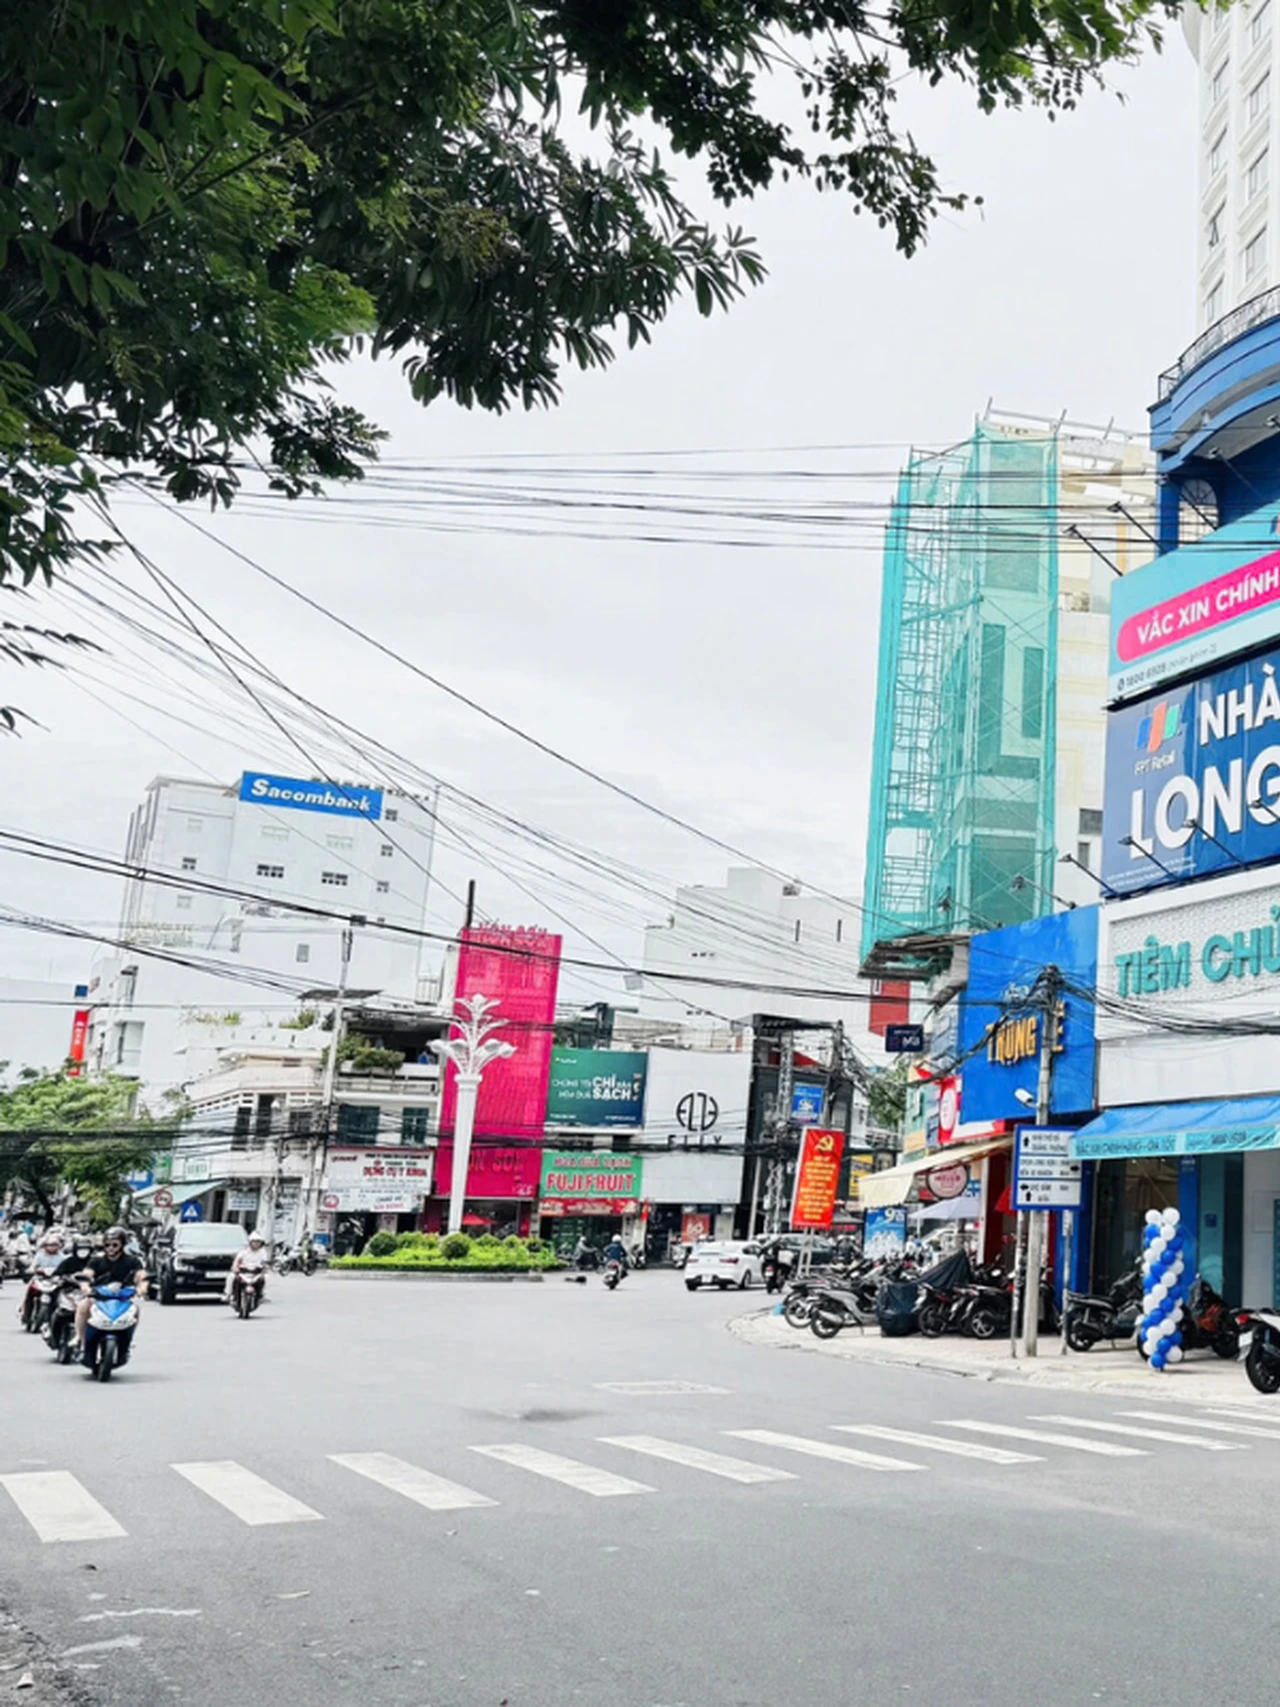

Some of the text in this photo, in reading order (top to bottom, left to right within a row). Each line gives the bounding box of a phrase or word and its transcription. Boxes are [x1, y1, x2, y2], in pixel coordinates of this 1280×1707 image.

[1137, 609, 1175, 647] VẮC
[1178, 597, 1211, 633] XIN
[1215, 566, 1280, 613] CHÍNH
[250, 778, 373, 813] Sacombank
[1115, 934, 1191, 998] TIÊM
